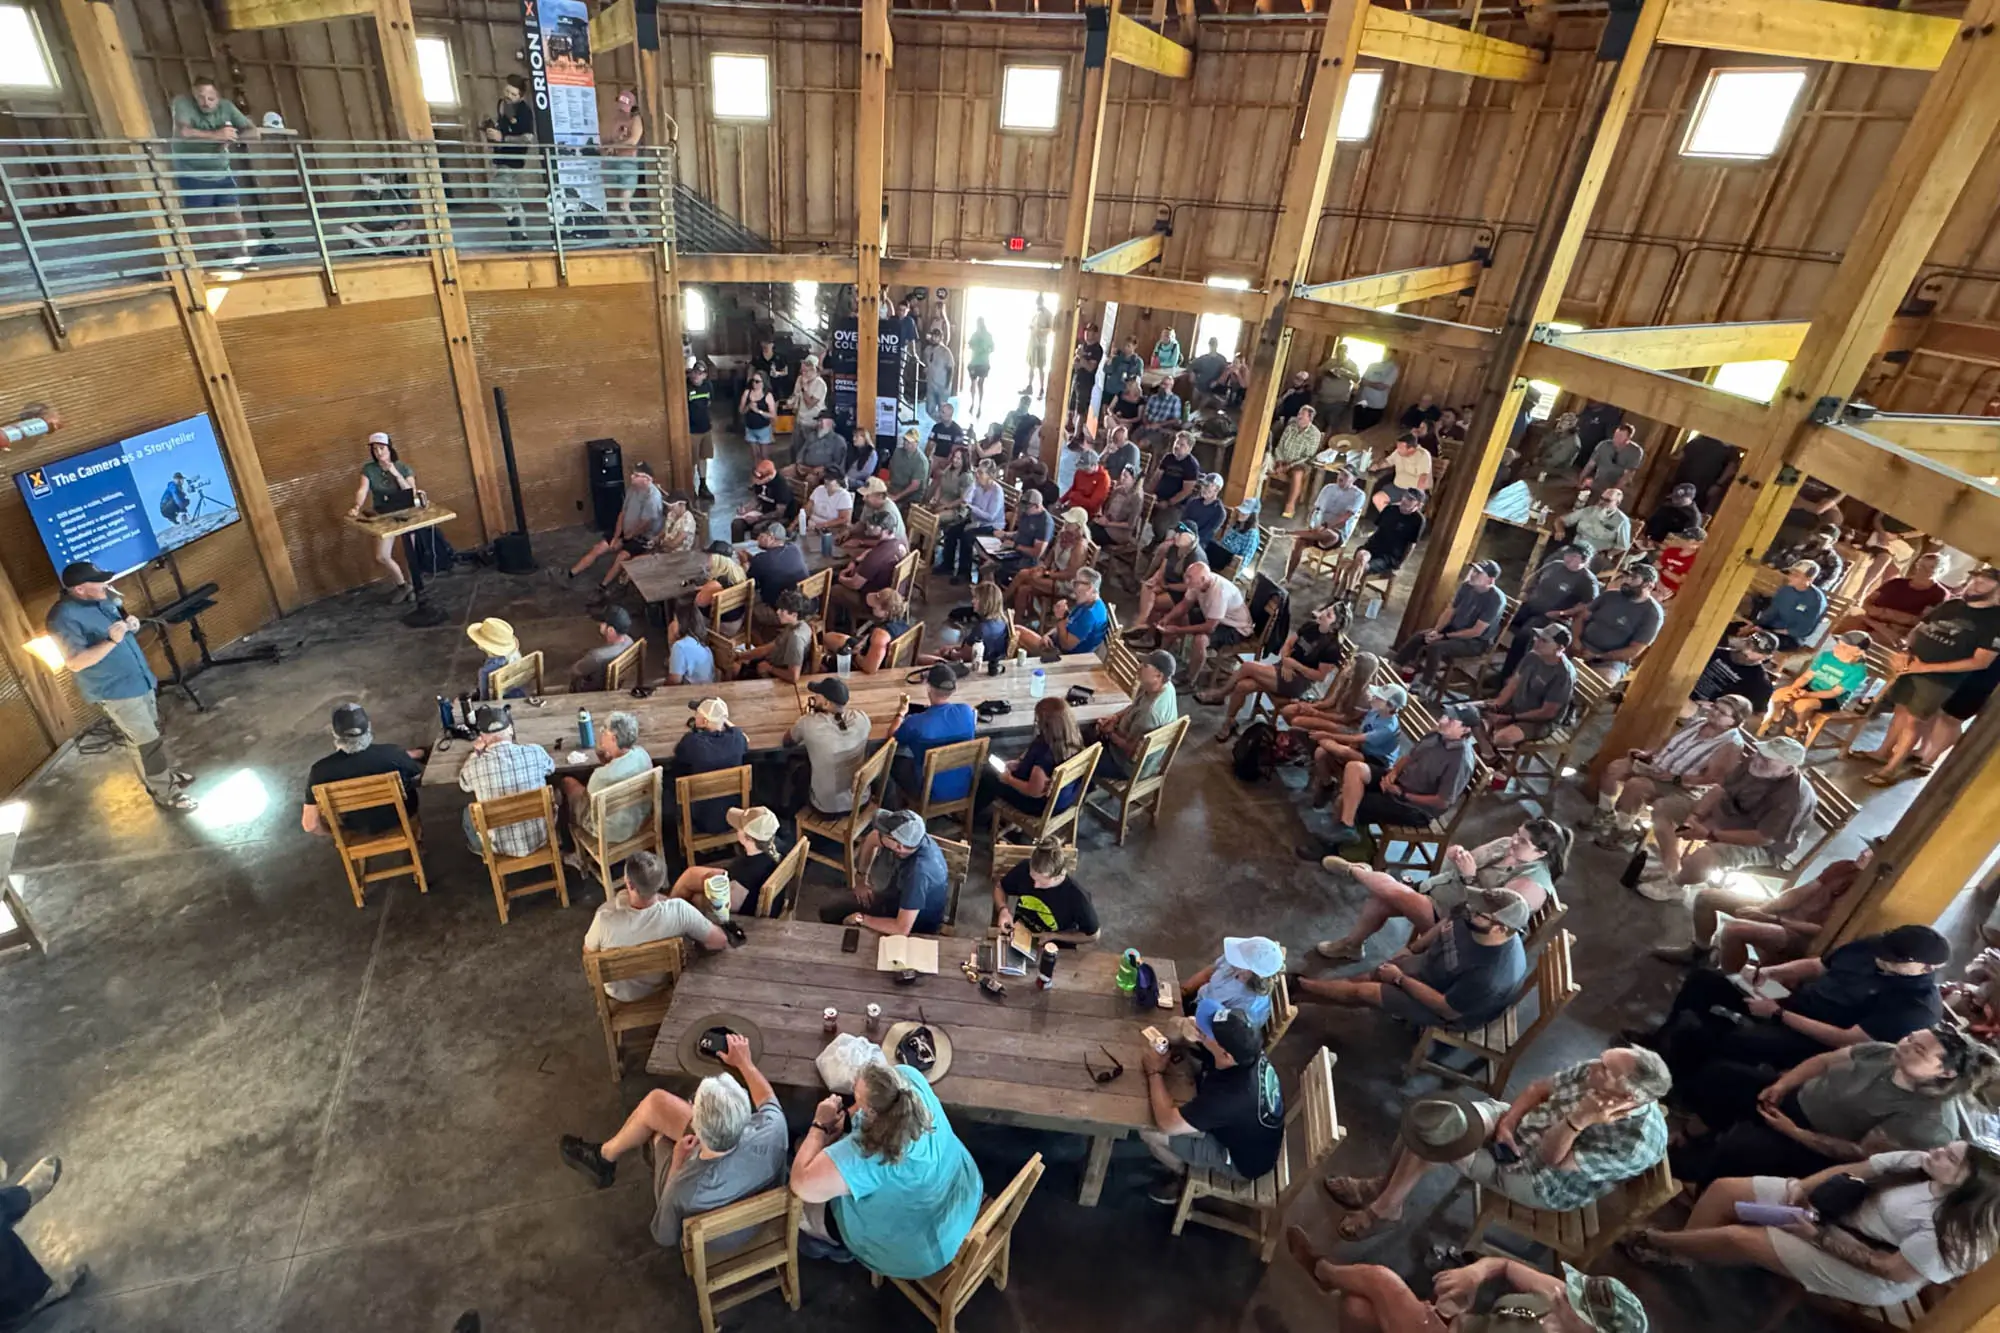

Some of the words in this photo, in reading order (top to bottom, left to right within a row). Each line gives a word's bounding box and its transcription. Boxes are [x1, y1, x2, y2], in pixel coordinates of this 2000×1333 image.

[527, 33, 548, 110] ORION
[51, 471, 77, 487] The
[77, 457, 120, 478] Camera
[121, 452, 135, 464] as
[136, 449, 143, 459] a
[144, 432, 195, 456] Storyteller
